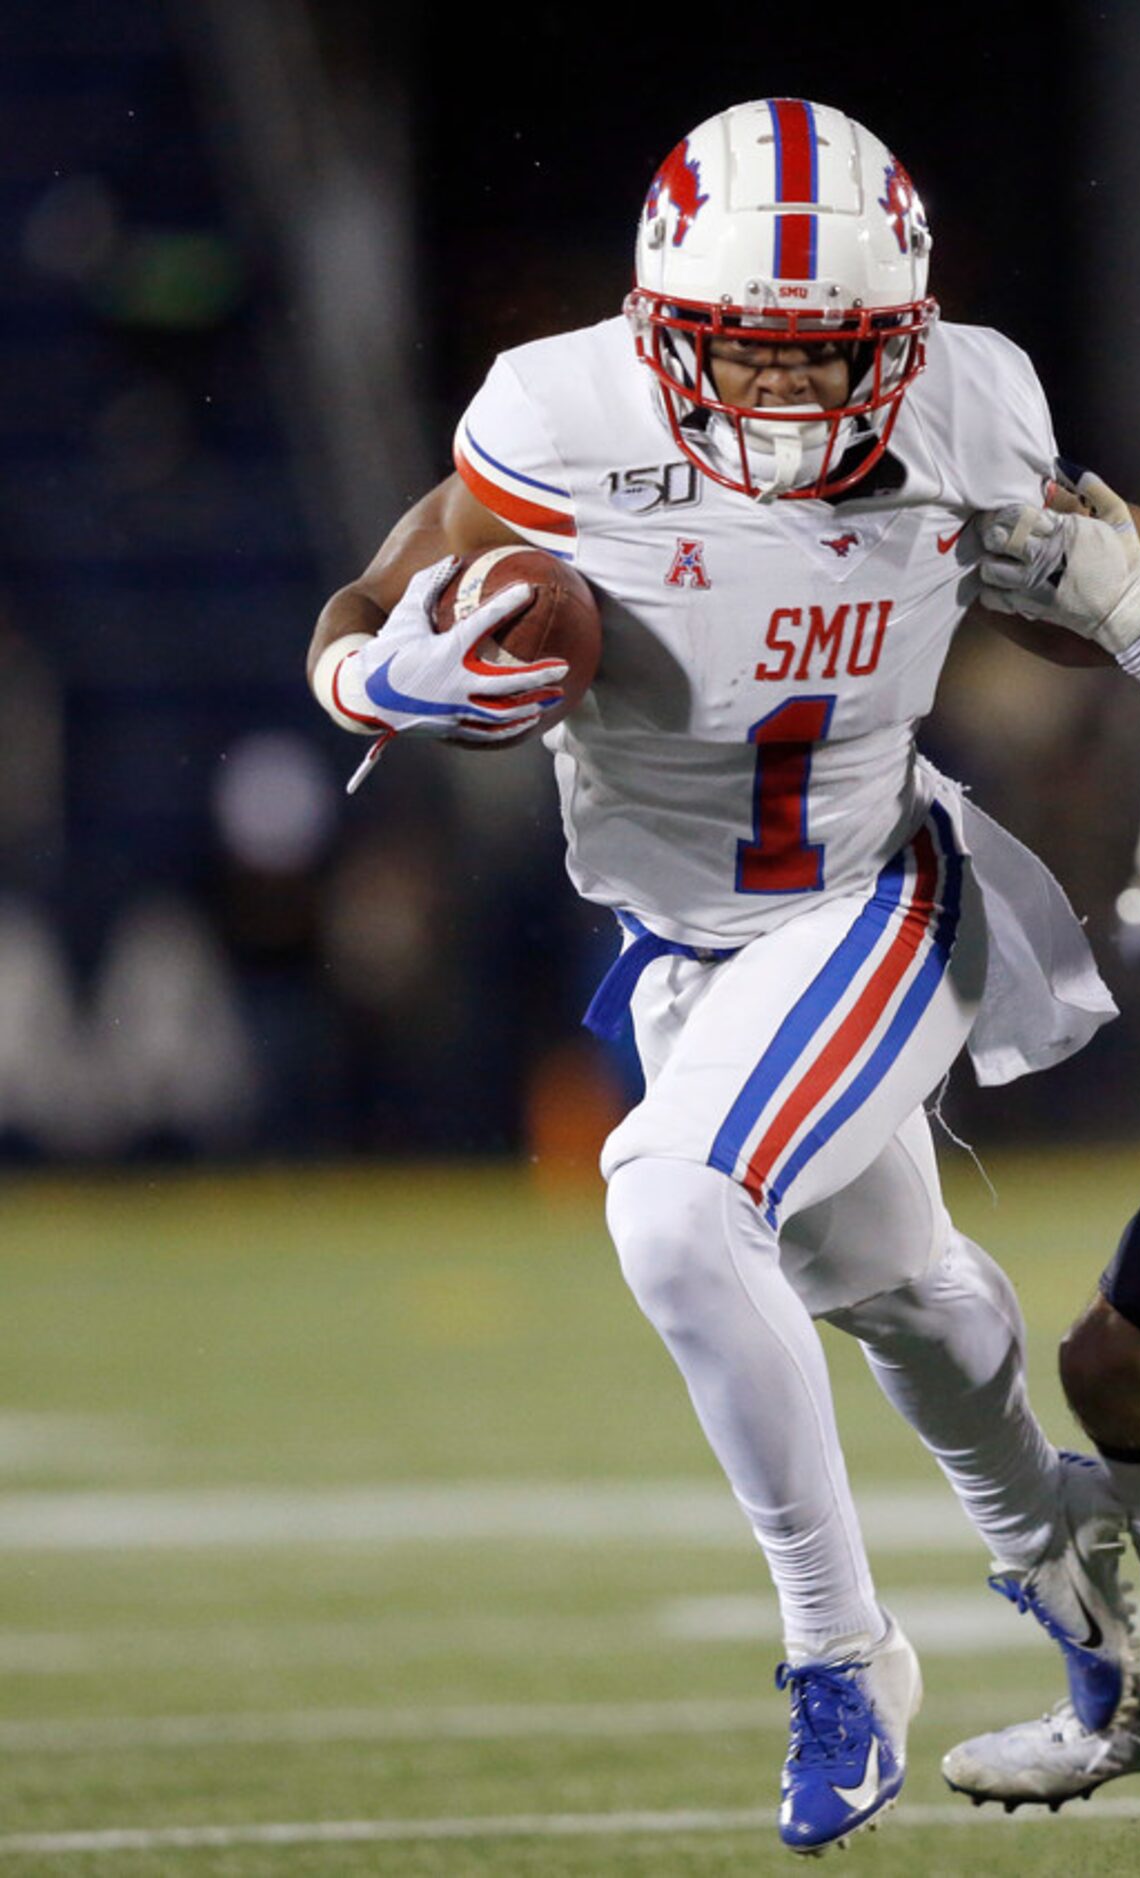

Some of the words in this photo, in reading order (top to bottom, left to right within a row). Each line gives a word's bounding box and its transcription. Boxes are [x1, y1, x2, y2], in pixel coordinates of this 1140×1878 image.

[779, 286, 808, 299] SMU
[601, 461, 699, 515] 150
[755, 600, 893, 681] SMU
[734, 694, 838, 894] 1
